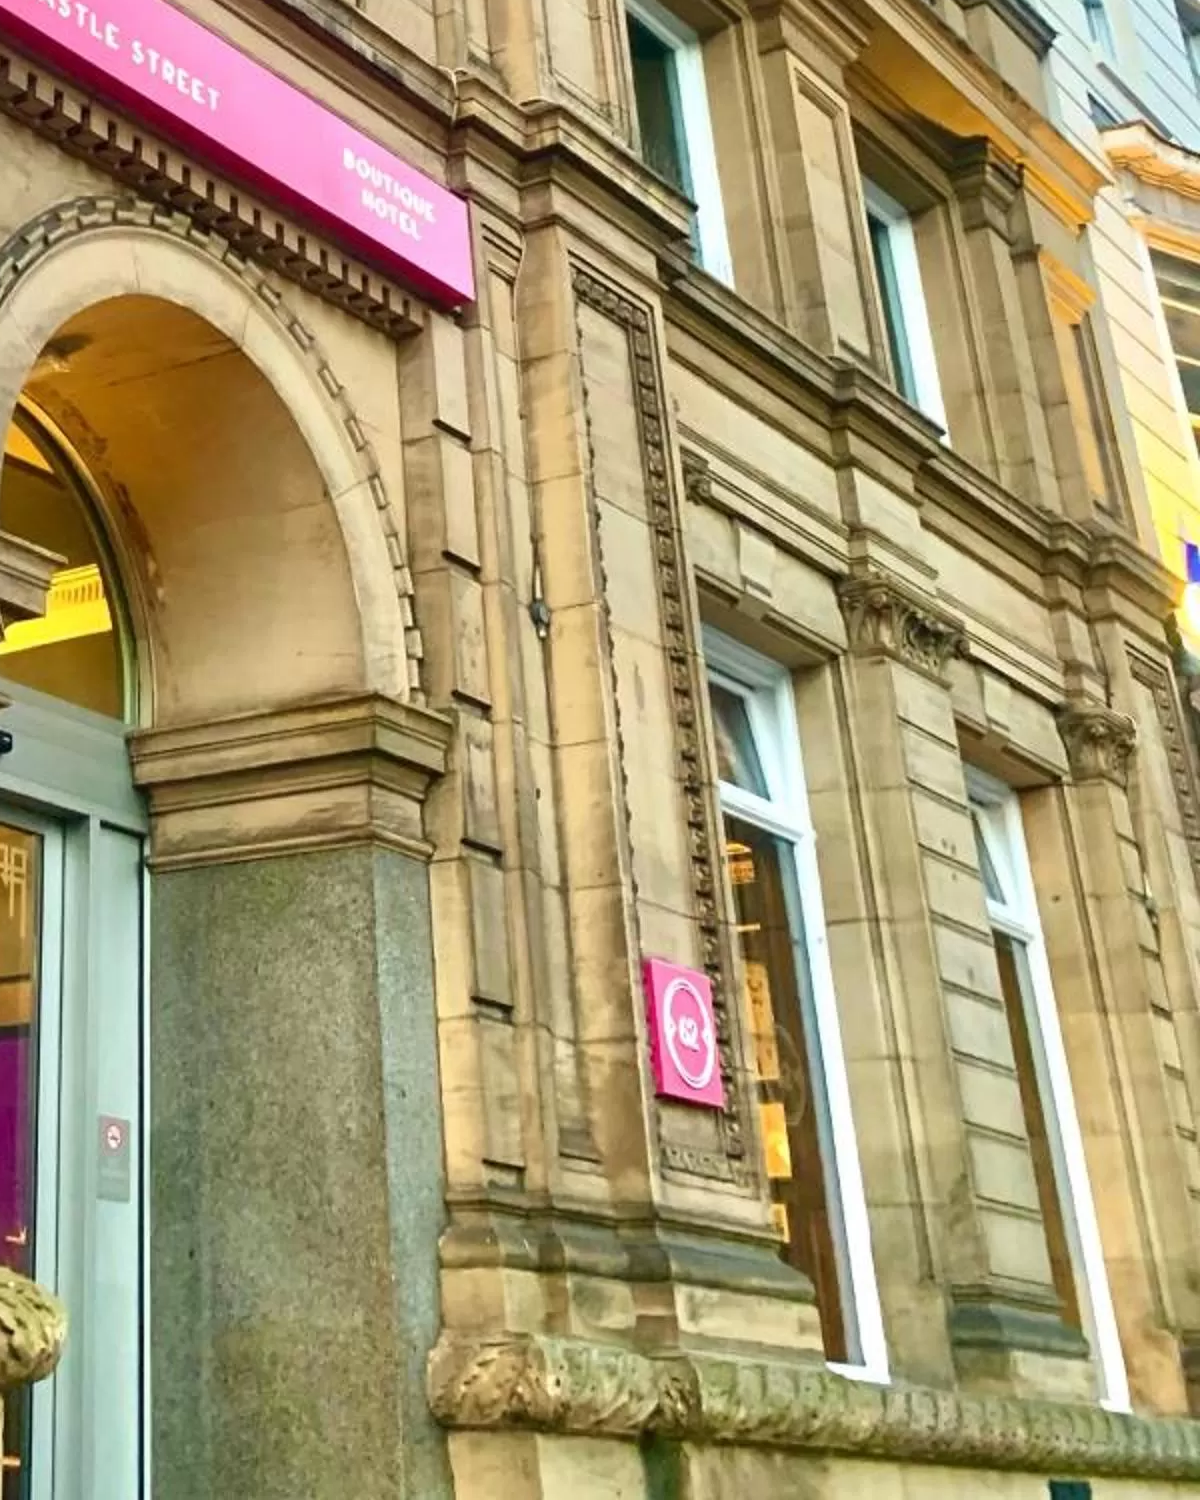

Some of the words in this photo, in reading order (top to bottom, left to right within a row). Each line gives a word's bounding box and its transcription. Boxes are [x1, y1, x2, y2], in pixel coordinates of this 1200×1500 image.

[131, 40, 221, 111] STREET
[342, 147, 436, 223] BOUTIQUE
[361, 188, 422, 241] HOTEL
